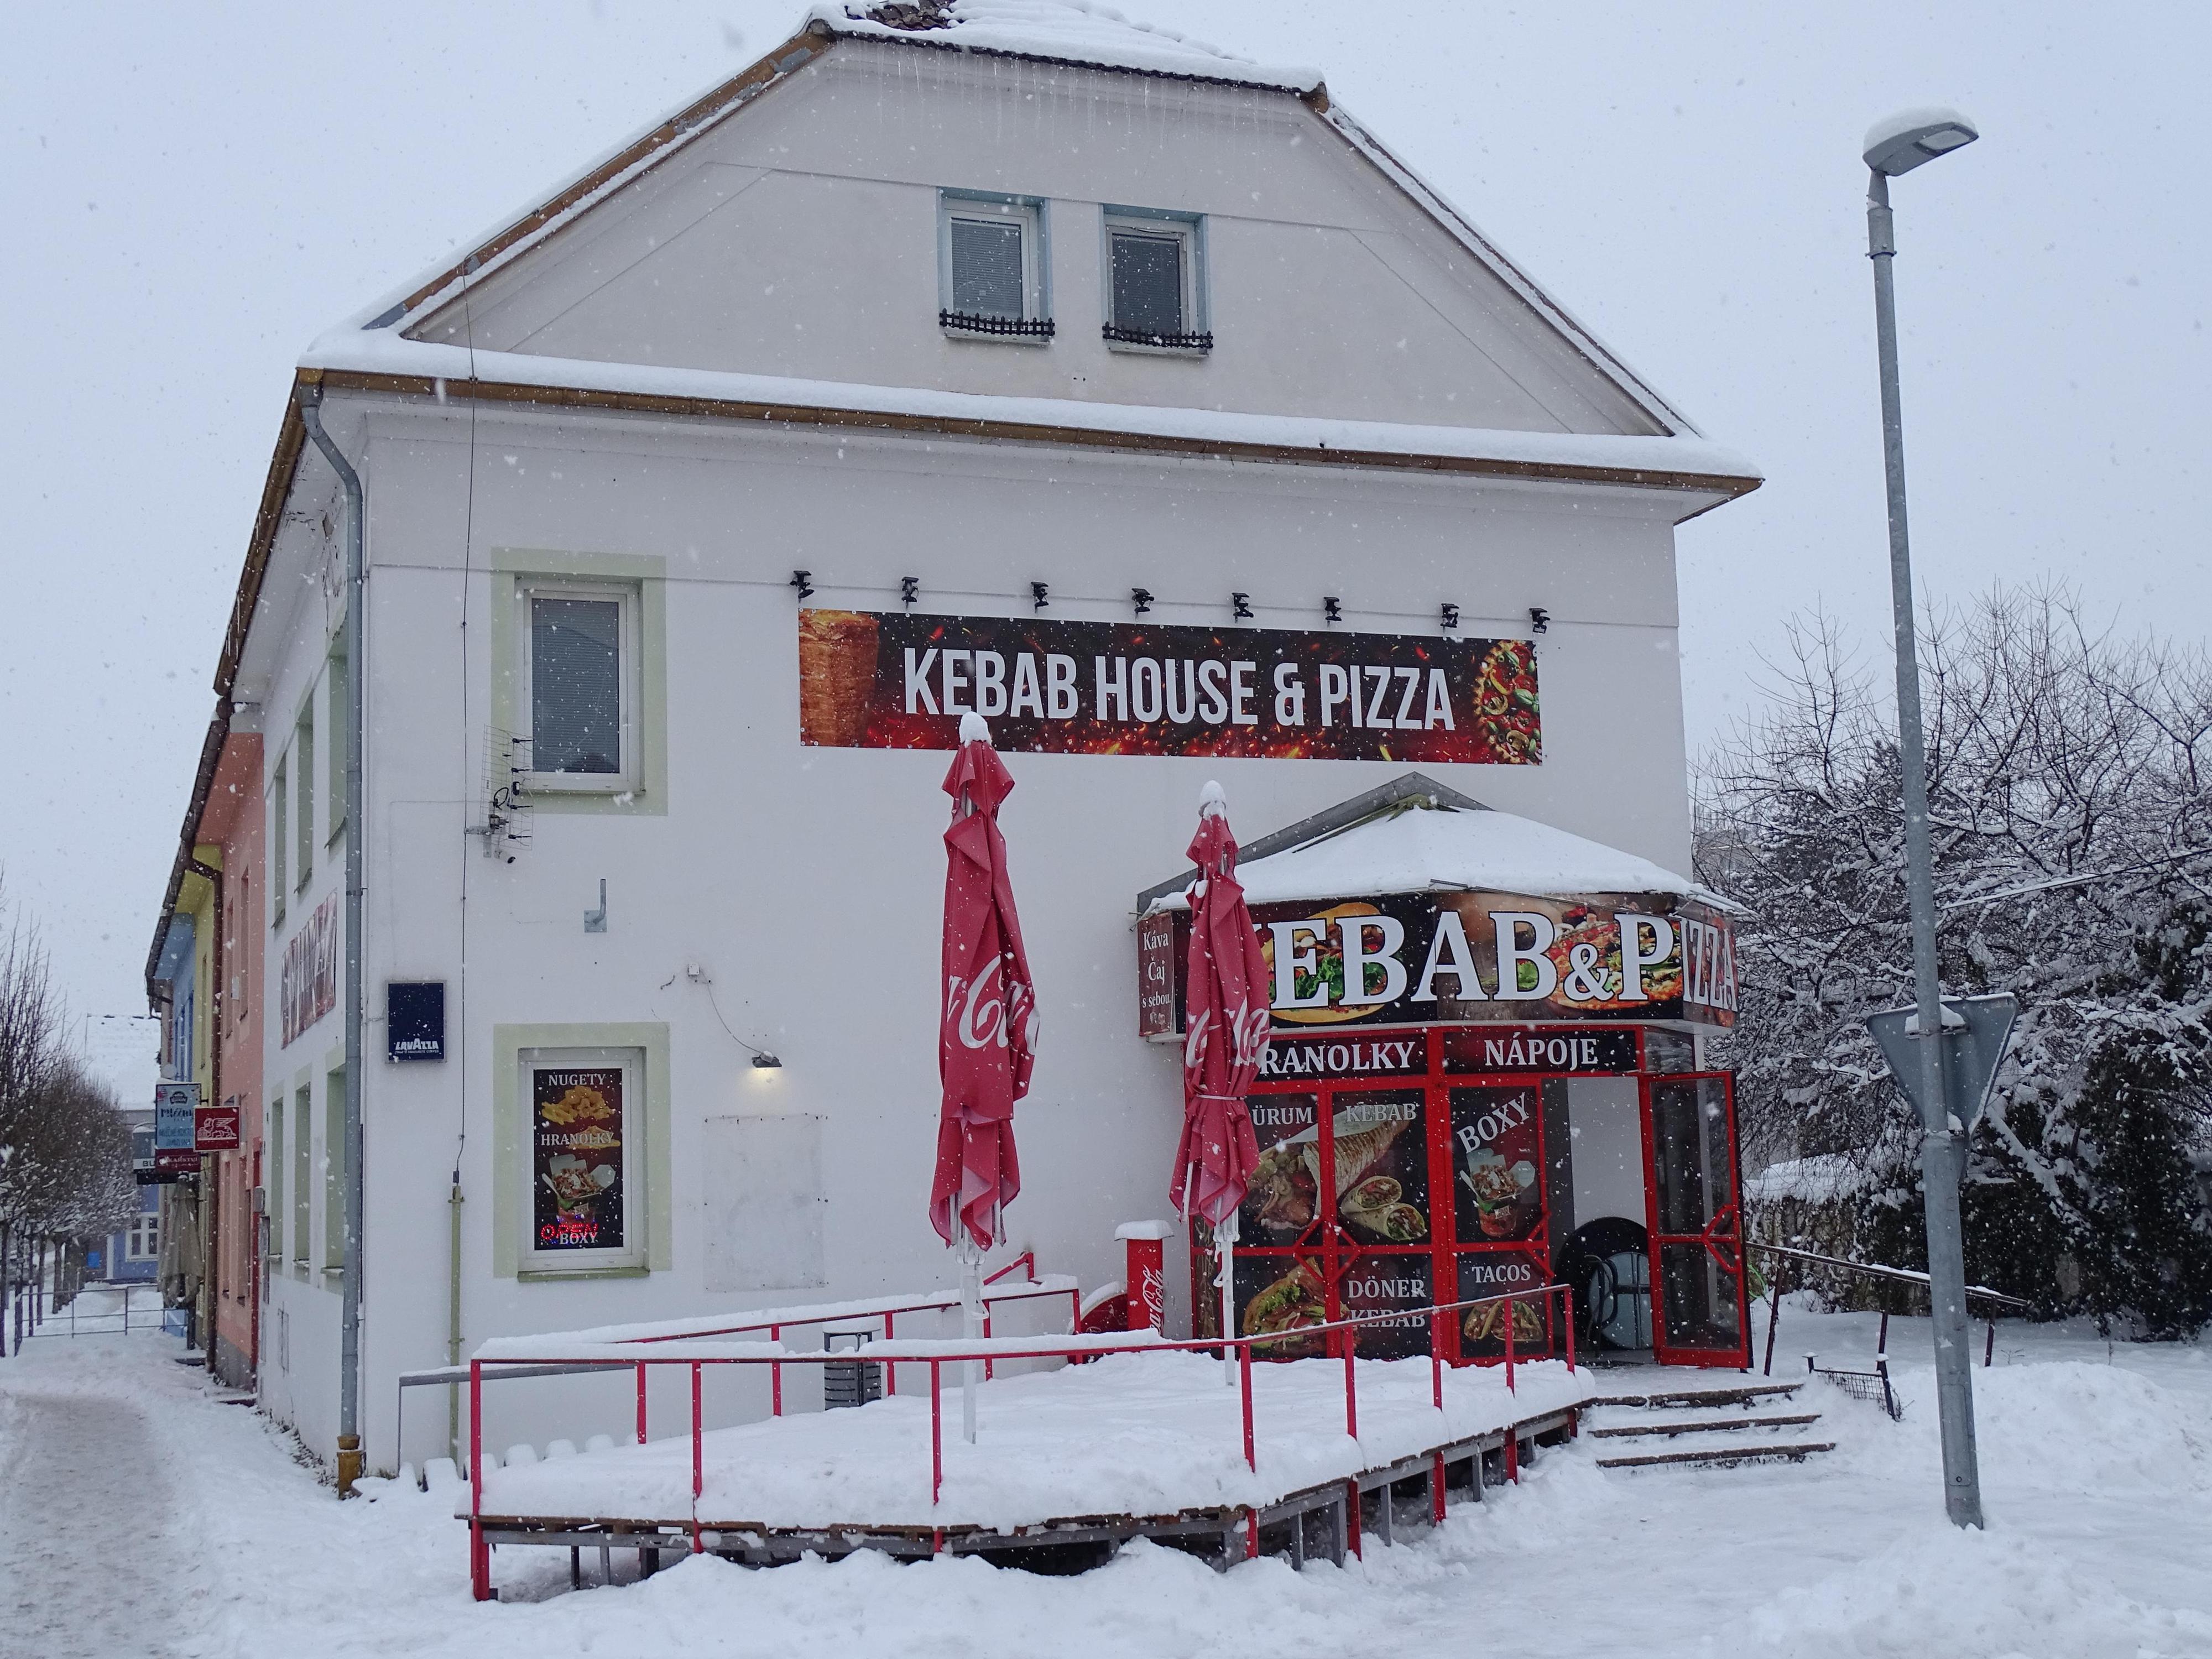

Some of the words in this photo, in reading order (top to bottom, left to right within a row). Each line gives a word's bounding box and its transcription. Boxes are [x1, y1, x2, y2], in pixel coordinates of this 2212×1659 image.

[904, 648, 1078, 718] KEBAB
[1095, 655, 1258, 724] HOUSE
[1274, 662, 1305, 726] &
[1319, 664, 1455, 731] PIZZA
[1143, 930, 1169, 951] Káva
[1147, 956, 1165, 985] Čaj
[1260, 1041, 1415, 1074] RANOLKY
[1484, 1032, 1598, 1071] NÁPOJE
[549, 1073, 606, 1086] NUGETY
[1251, 1105, 1314, 1126] ÜRUM
[1345, 1103, 1417, 1123] KEBAB
[1456, 1092, 1531, 1154] BOXY
[541, 1132, 614, 1146] HRANOLKY
[541, 1223, 598, 1240] OPEN
[559, 1232, 598, 1245] BOXY
[1471, 1264, 1531, 1284] TACOS
[1348, 1276, 1426, 1298] DÖNER
